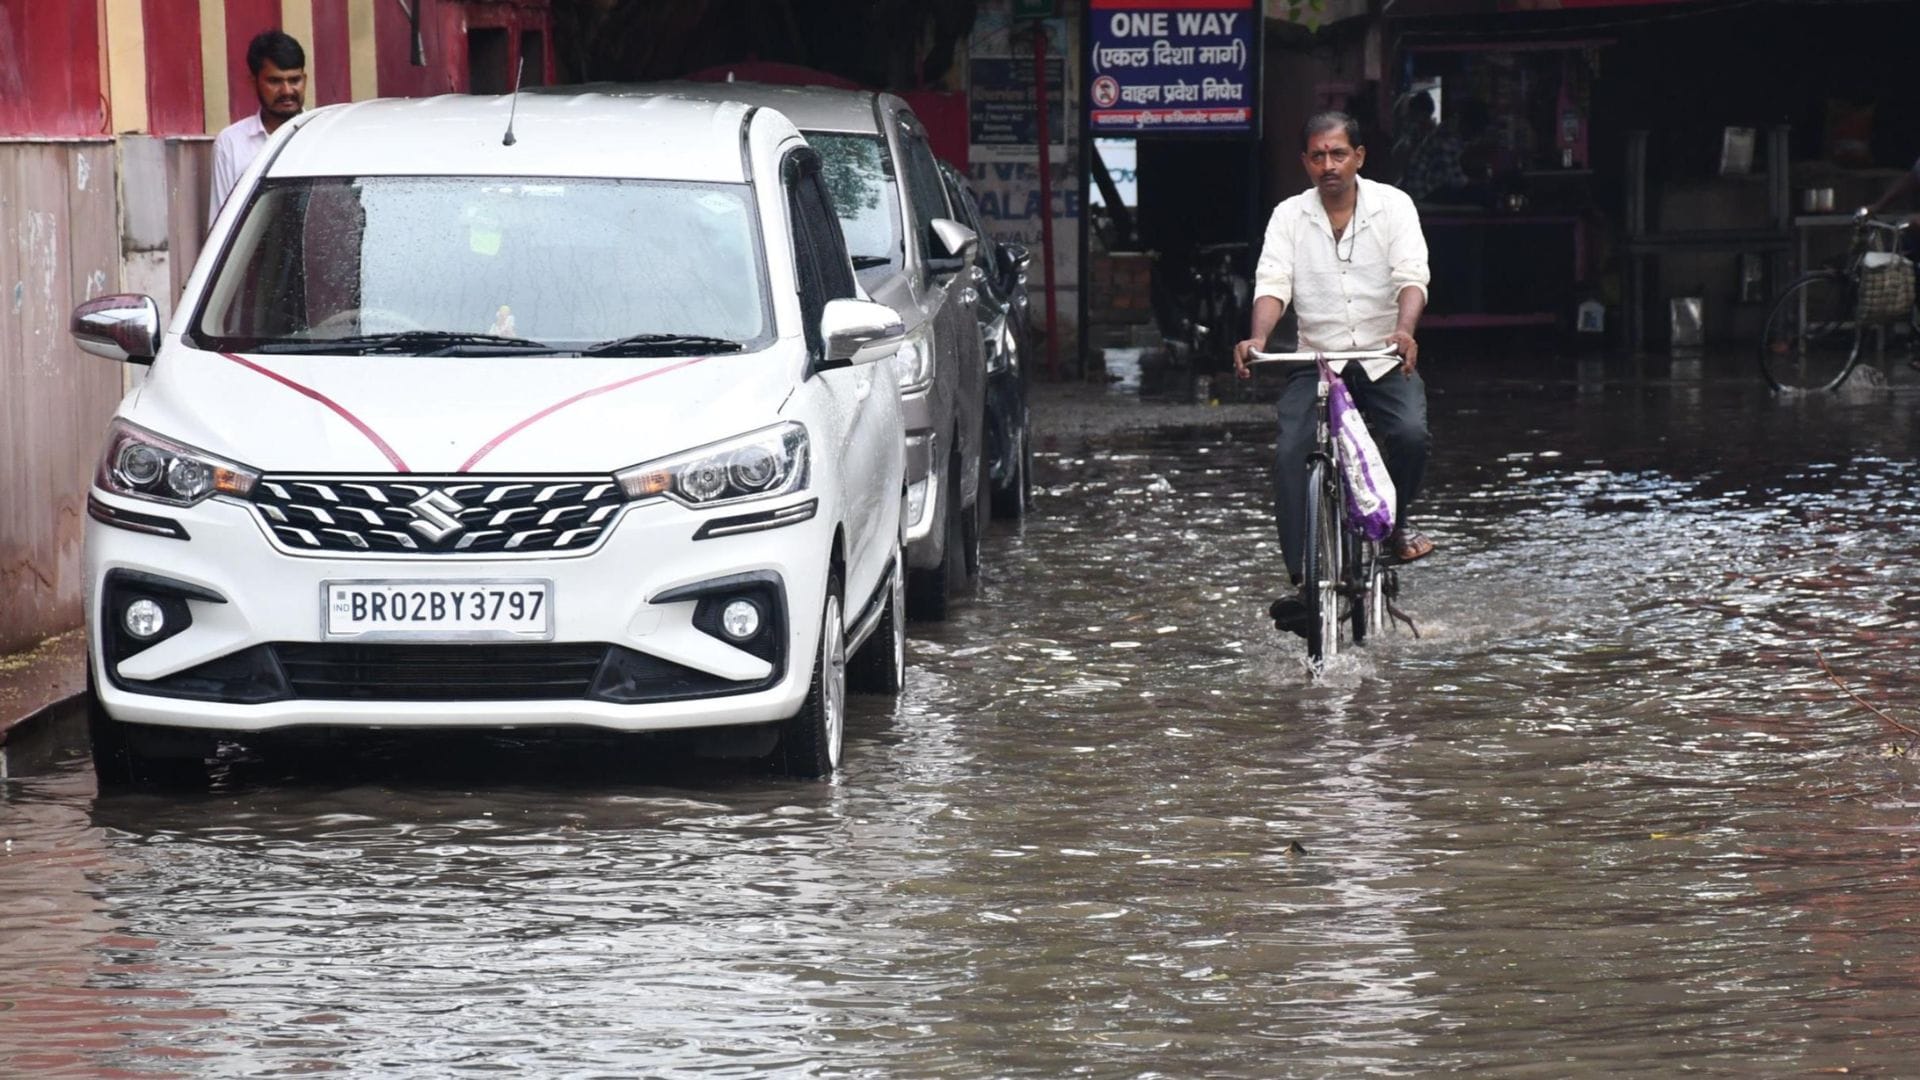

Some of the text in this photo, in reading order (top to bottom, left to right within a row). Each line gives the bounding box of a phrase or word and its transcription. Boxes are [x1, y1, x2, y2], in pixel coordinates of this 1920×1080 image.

[1110, 12, 1239, 38] ONE WAY
[1092, 41, 1150, 74] (एकल
[1152, 39, 1196, 66] दिशा
[1199, 37, 1247, 71] मार्ग)
[1121, 76, 1244, 104] वाहन प्रवेश निषेध
[333, 604, 350, 613] IND
[351, 591, 545, 622] BR02BY3797
